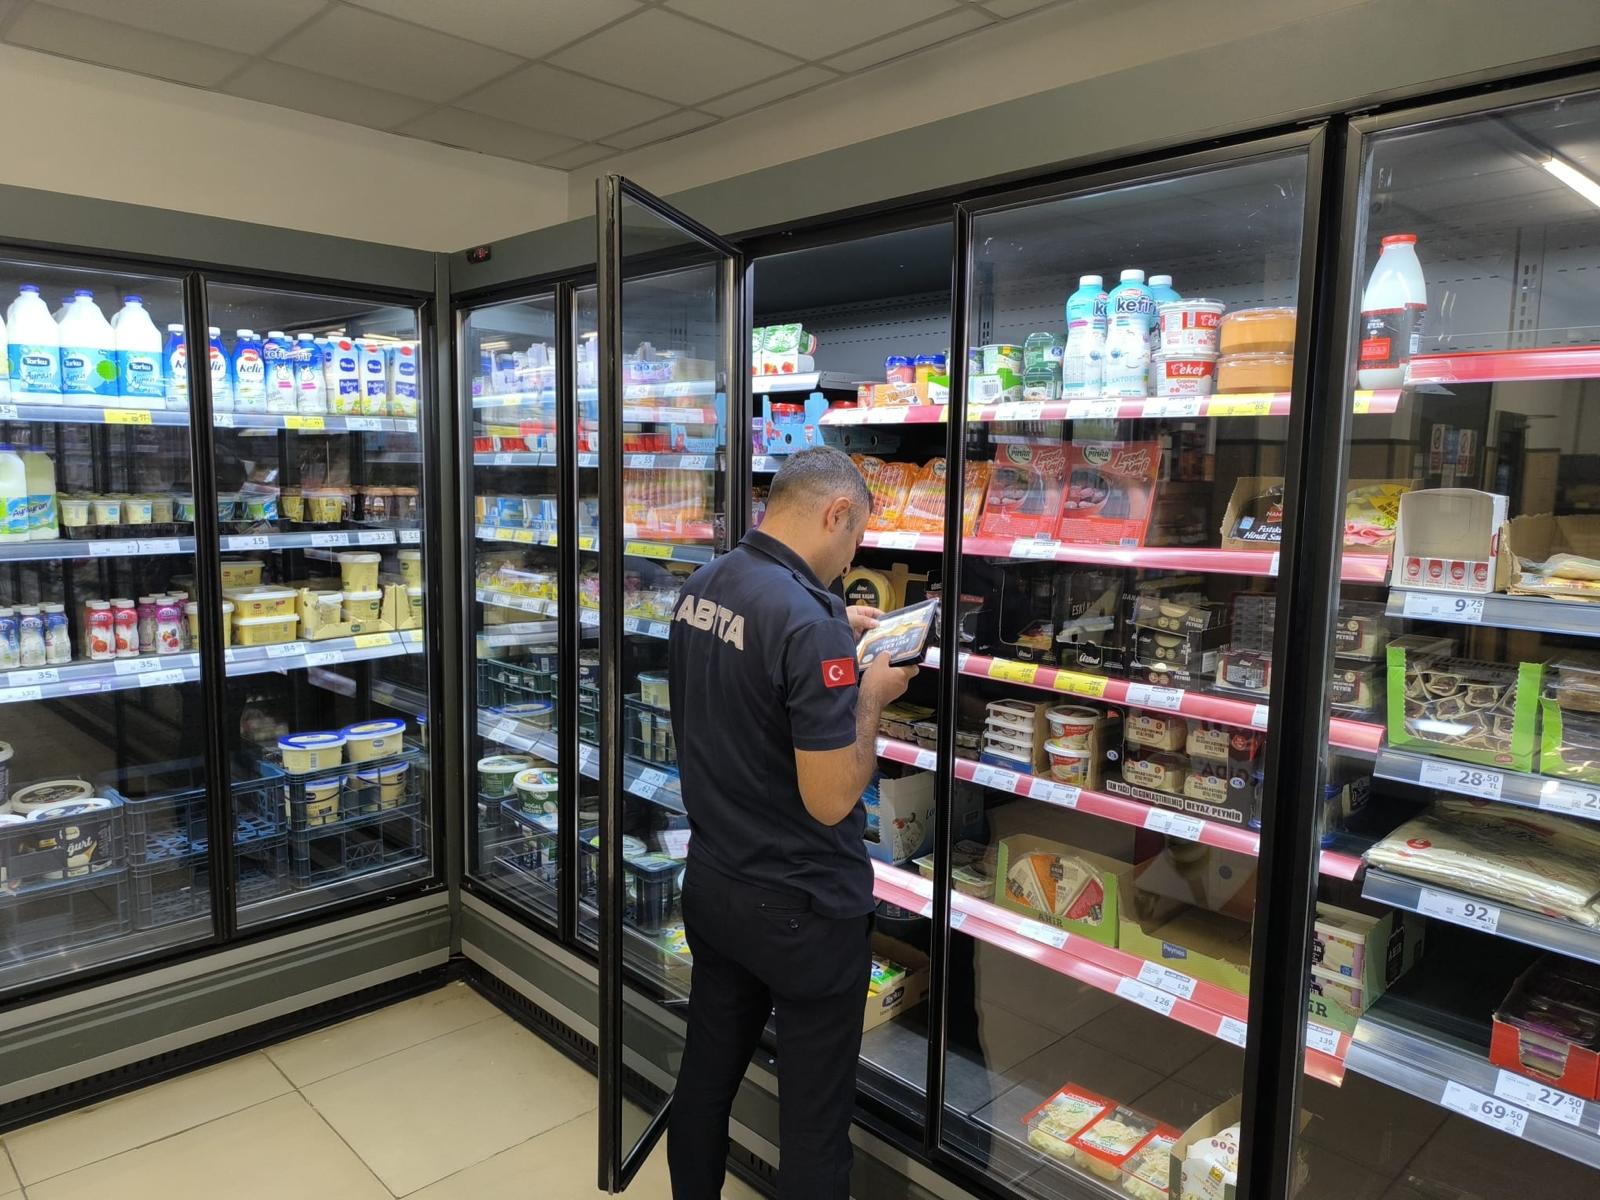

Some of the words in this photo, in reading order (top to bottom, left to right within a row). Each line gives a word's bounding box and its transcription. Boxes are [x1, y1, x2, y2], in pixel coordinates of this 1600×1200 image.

[25, 356, 48, 366] Torku
[1170, 363, 1204, 376] Eker
[672, 594, 745, 651] ABITA
[1186, 801, 1211, 813] BEYAZ
[1211, 807, 1241, 821] PEYNİR
[1463, 903, 1488, 922] 92
[1481, 1100, 1524, 1121] 69,50
